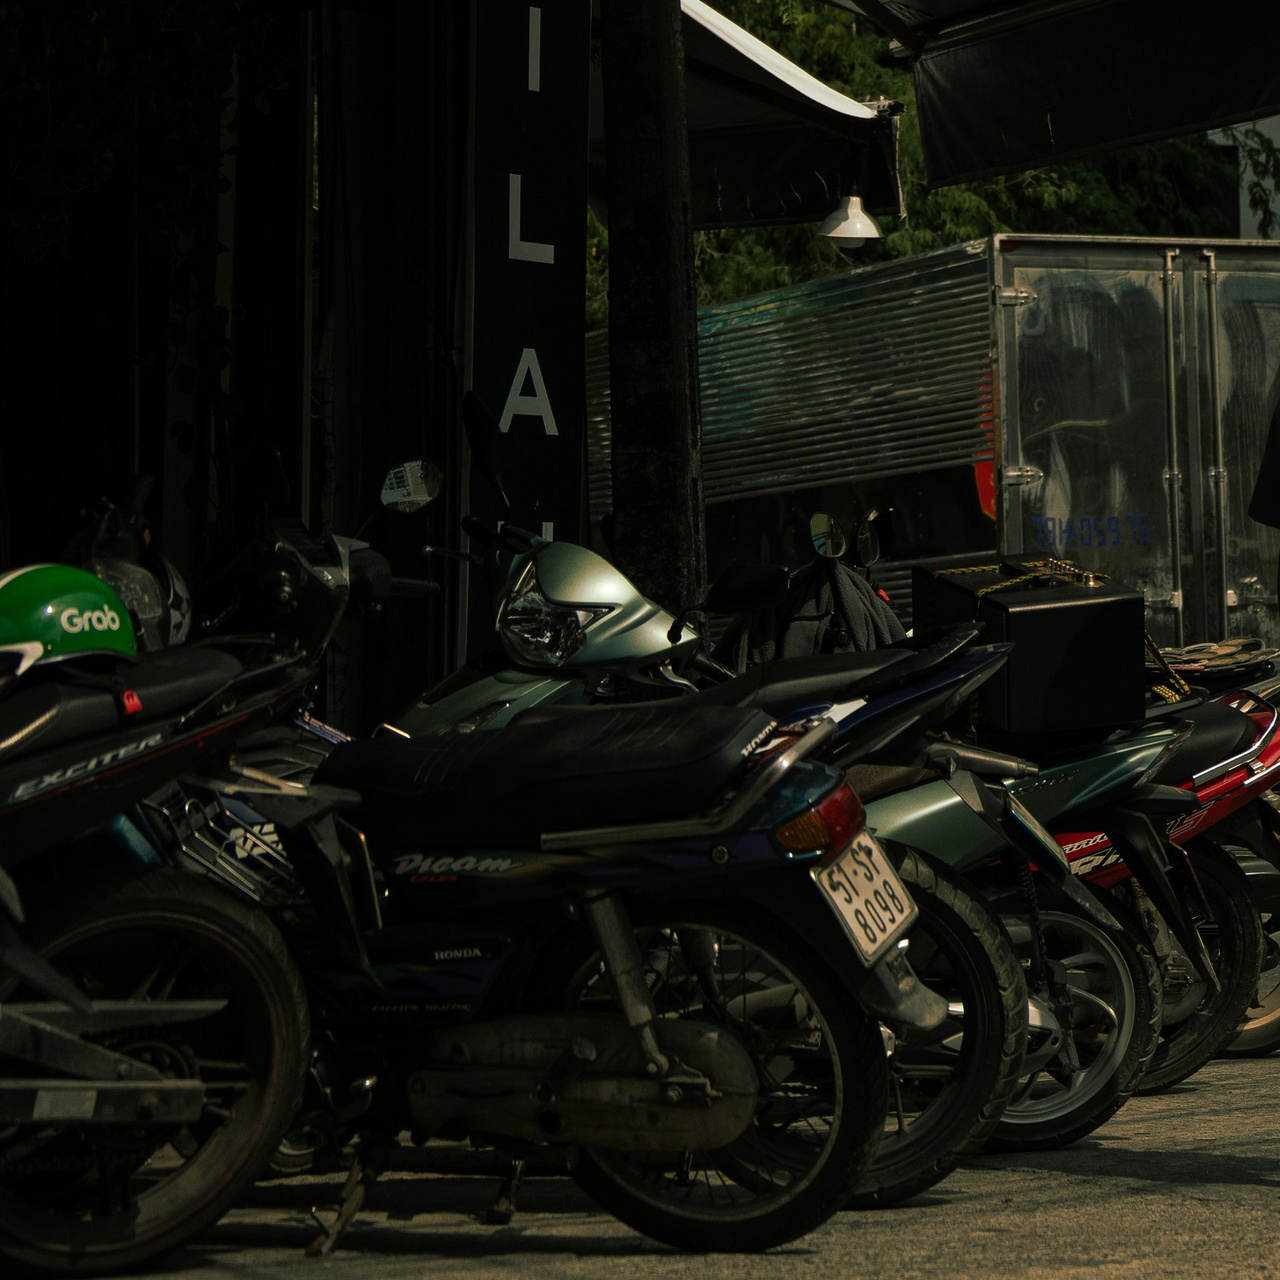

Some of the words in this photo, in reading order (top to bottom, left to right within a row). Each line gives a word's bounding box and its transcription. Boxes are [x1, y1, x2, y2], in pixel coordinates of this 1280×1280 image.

[61, 604, 120, 634] Grab
[9, 733, 163, 803] EXCITER
[854, 880, 904, 944] 8098
[434, 947, 482, 961] HONDA
